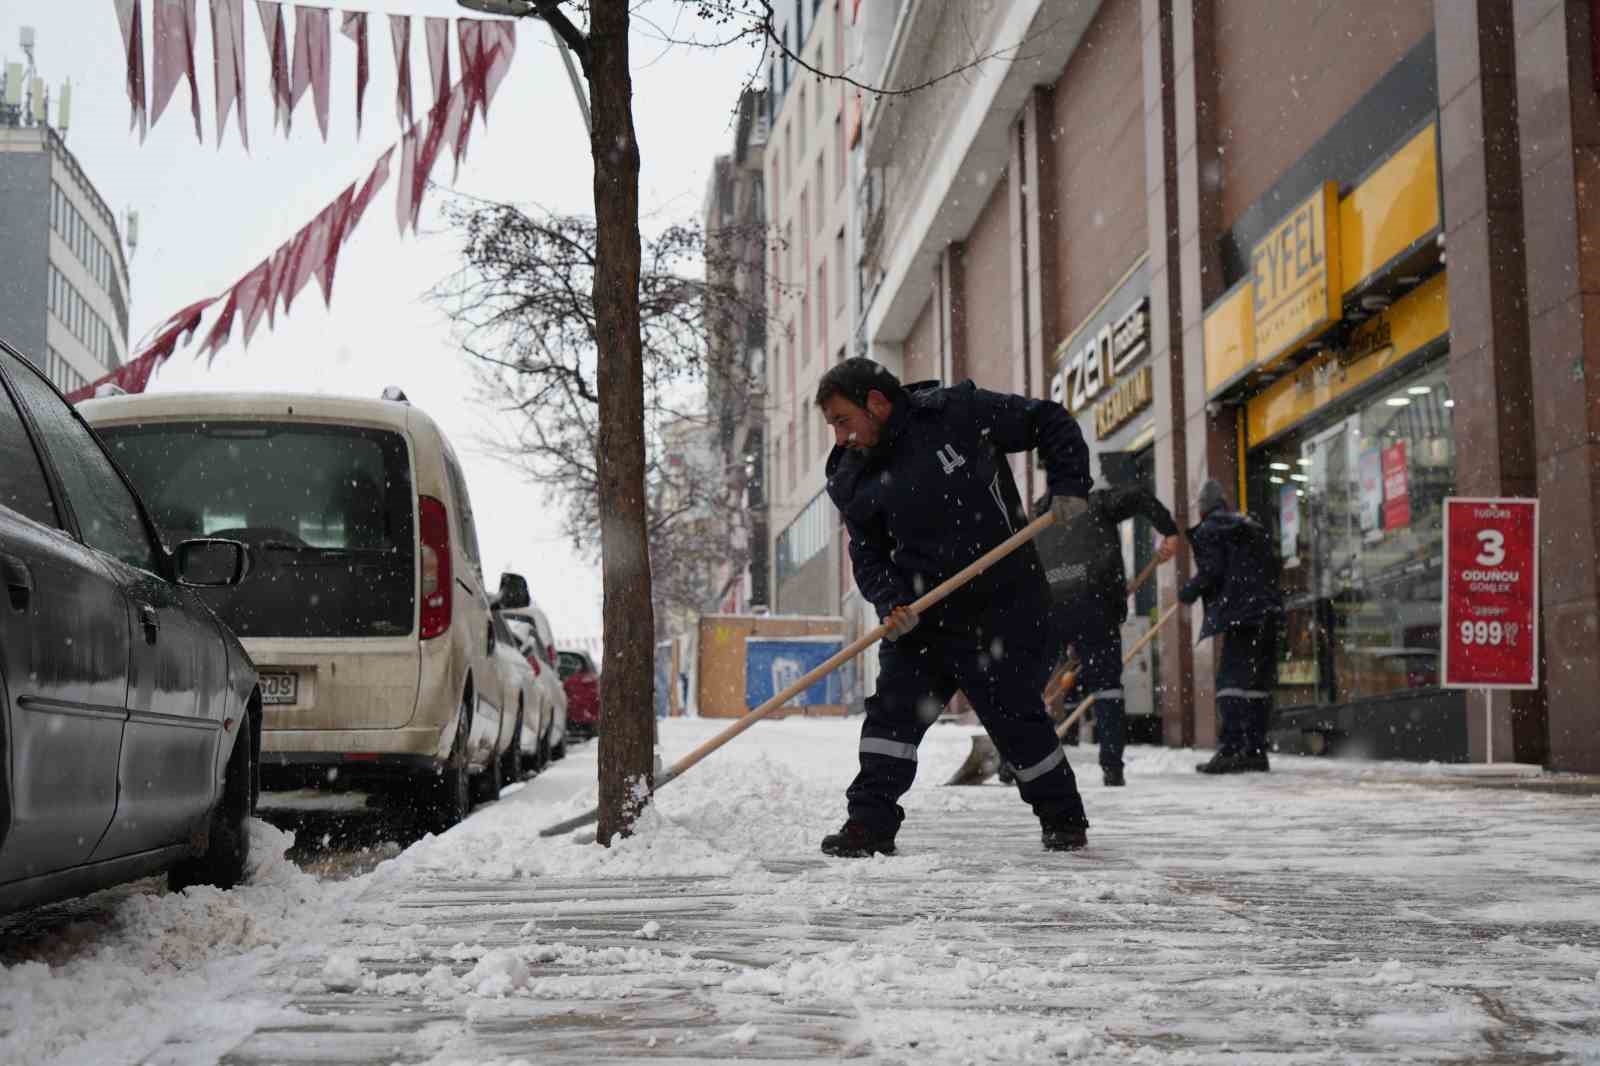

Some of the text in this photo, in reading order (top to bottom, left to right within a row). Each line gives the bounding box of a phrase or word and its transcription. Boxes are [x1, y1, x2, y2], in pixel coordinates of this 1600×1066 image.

[1253, 204, 1323, 312] EYFEL
[1475, 528, 1505, 567] 3
[1461, 570, 1520, 582] ODUNCU
[1460, 620, 1502, 645] 999
